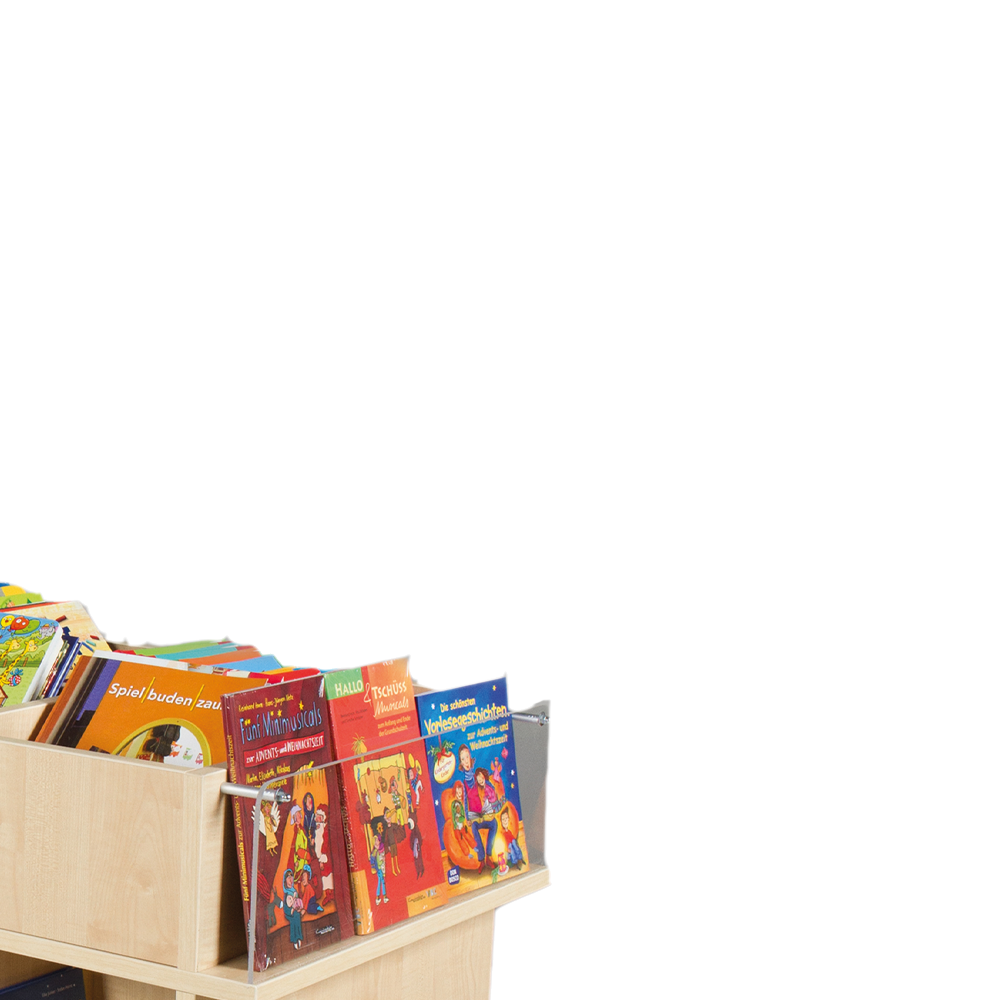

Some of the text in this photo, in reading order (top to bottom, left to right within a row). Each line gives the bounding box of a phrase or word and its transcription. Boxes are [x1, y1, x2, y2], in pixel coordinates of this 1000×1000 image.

[335, 680, 363, 697] HALLO
[371, 680, 407, 700] TSCHÜSS
[440, 698, 476, 713] Die schönsten
[240, 702, 322, 745] Fünf Minimusicals
[499, 722, 509, 731] und
